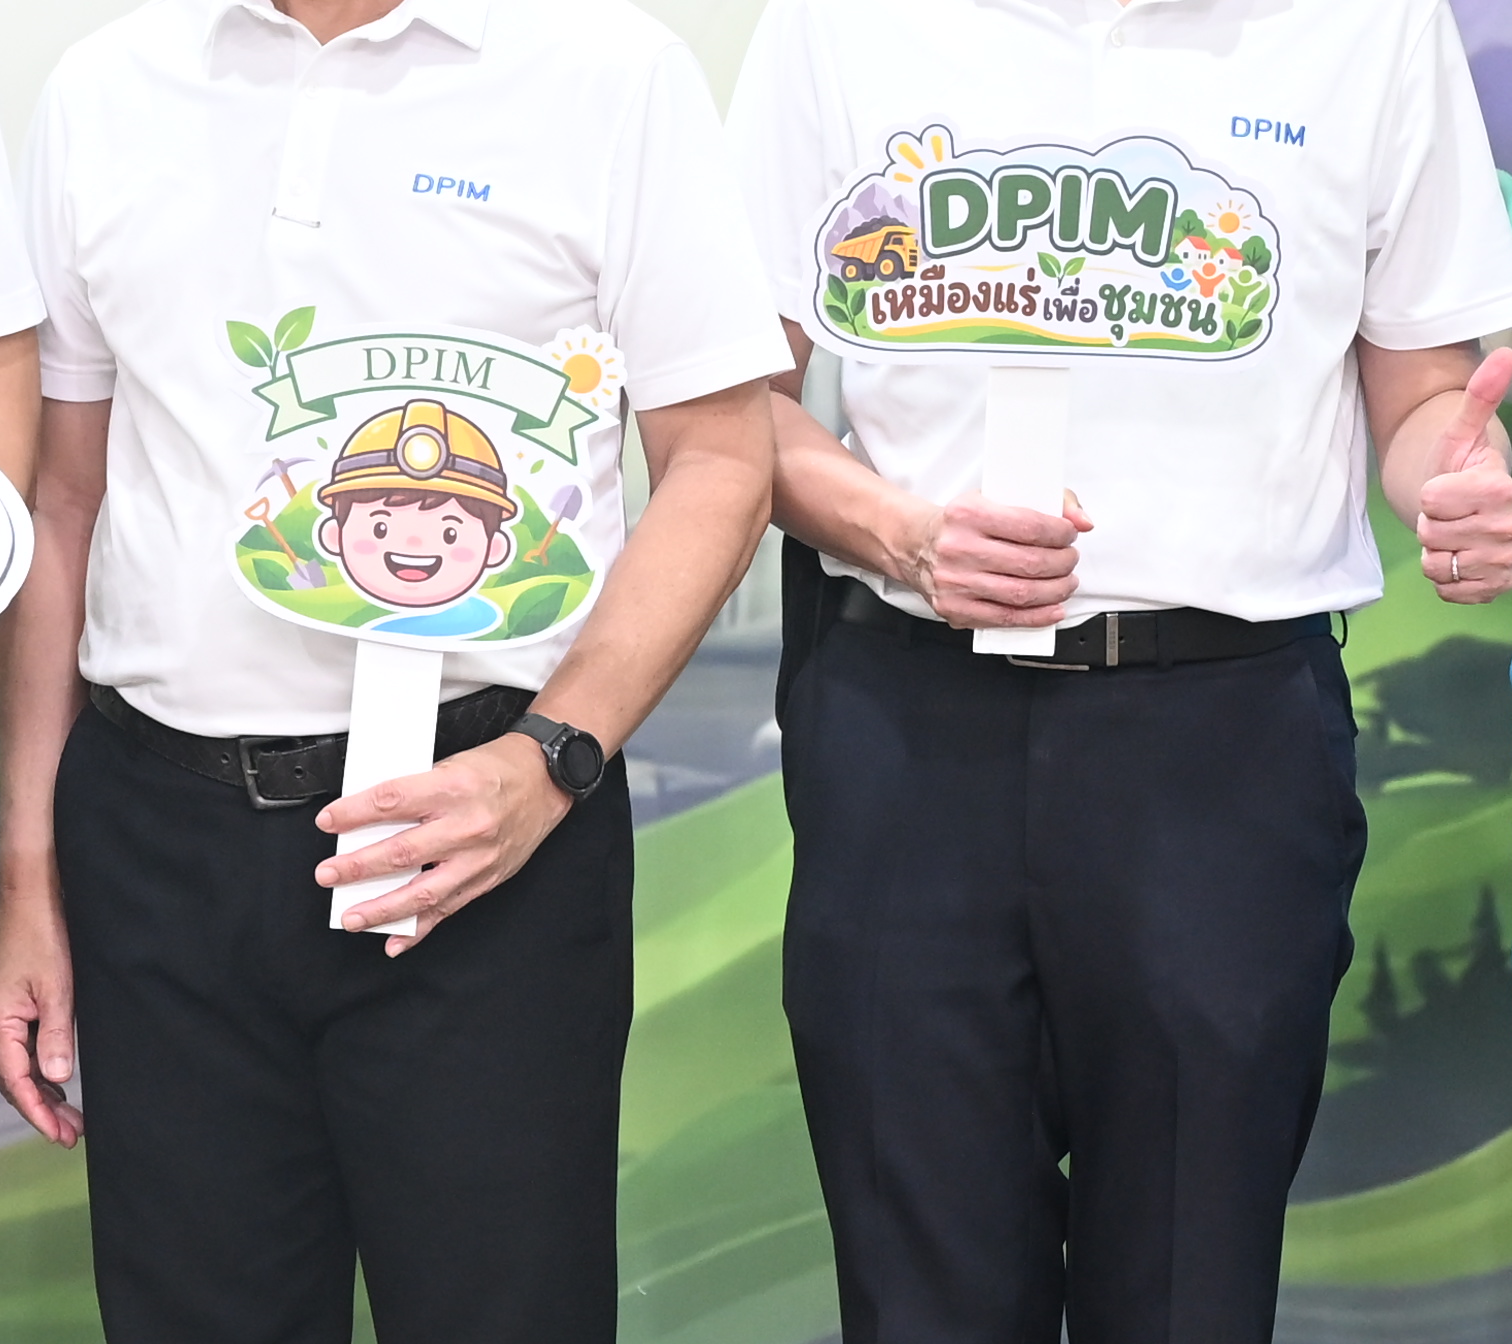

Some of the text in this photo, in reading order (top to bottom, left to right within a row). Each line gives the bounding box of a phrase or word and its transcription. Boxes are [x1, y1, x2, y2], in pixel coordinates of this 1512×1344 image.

[1230, 116, 1307, 148] DPIM
[412, 172, 491, 202] DPIM
[928, 174, 1169, 258] DPIM
[362, 346, 497, 392] DPIM
